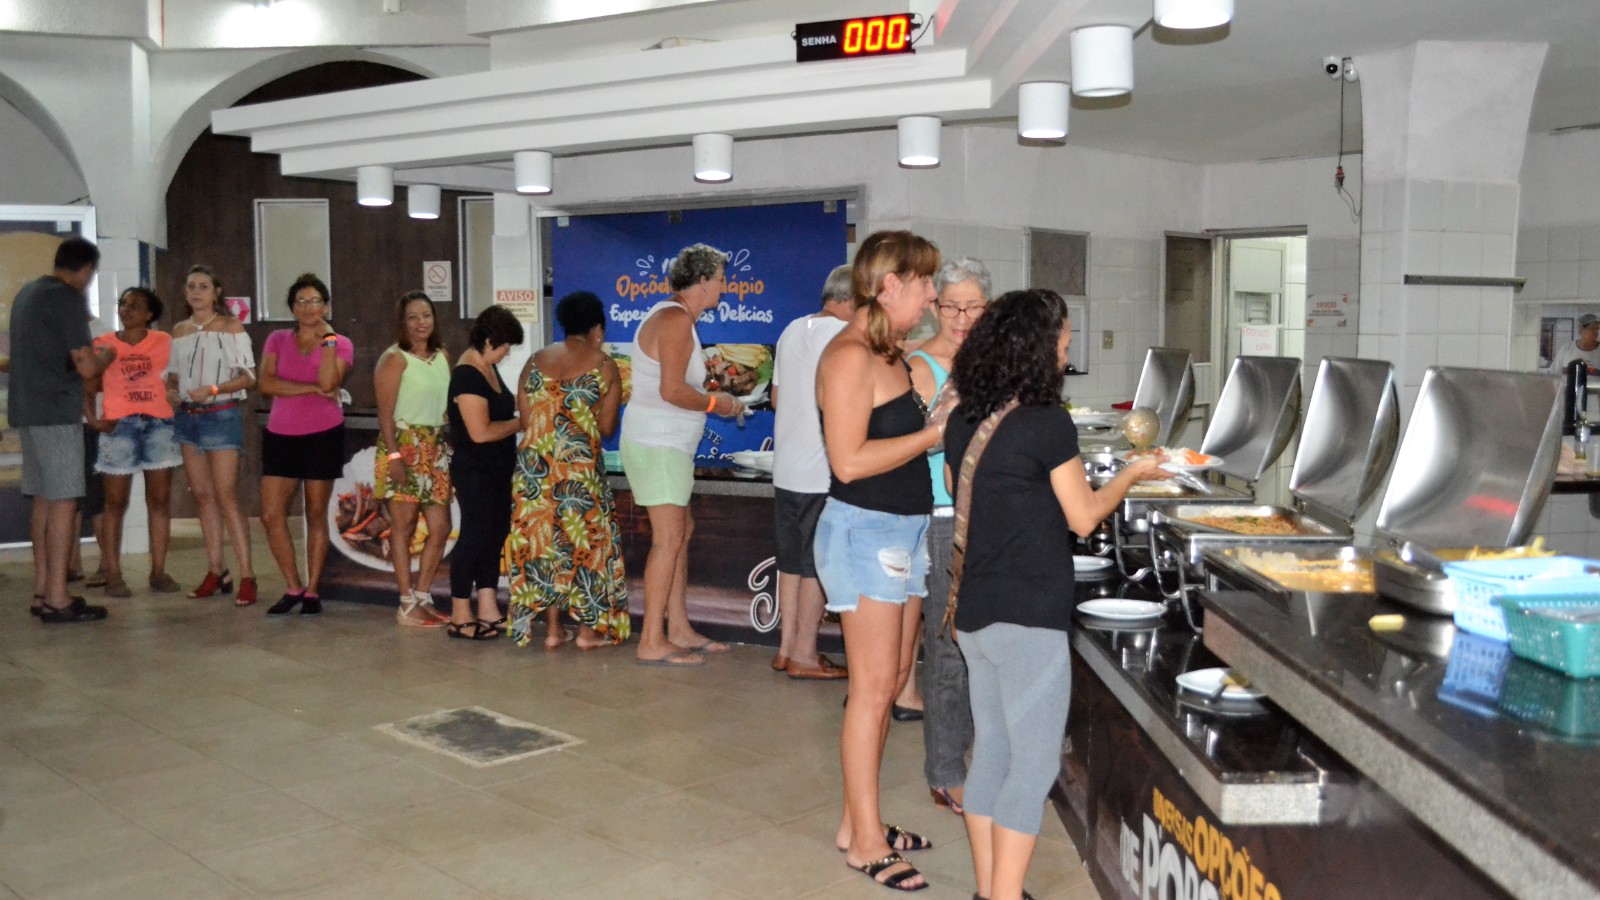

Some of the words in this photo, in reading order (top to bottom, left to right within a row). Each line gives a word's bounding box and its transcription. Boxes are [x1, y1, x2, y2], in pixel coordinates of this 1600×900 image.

[801, 35, 837, 46] SENHA
[844, 18, 907, 54] 000
[500, 290, 533, 301] AVISO
[717, 301, 773, 323] Delícias
[1120, 816, 1141, 897] DE
[1193, 815, 1283, 900] OPÇÕE
